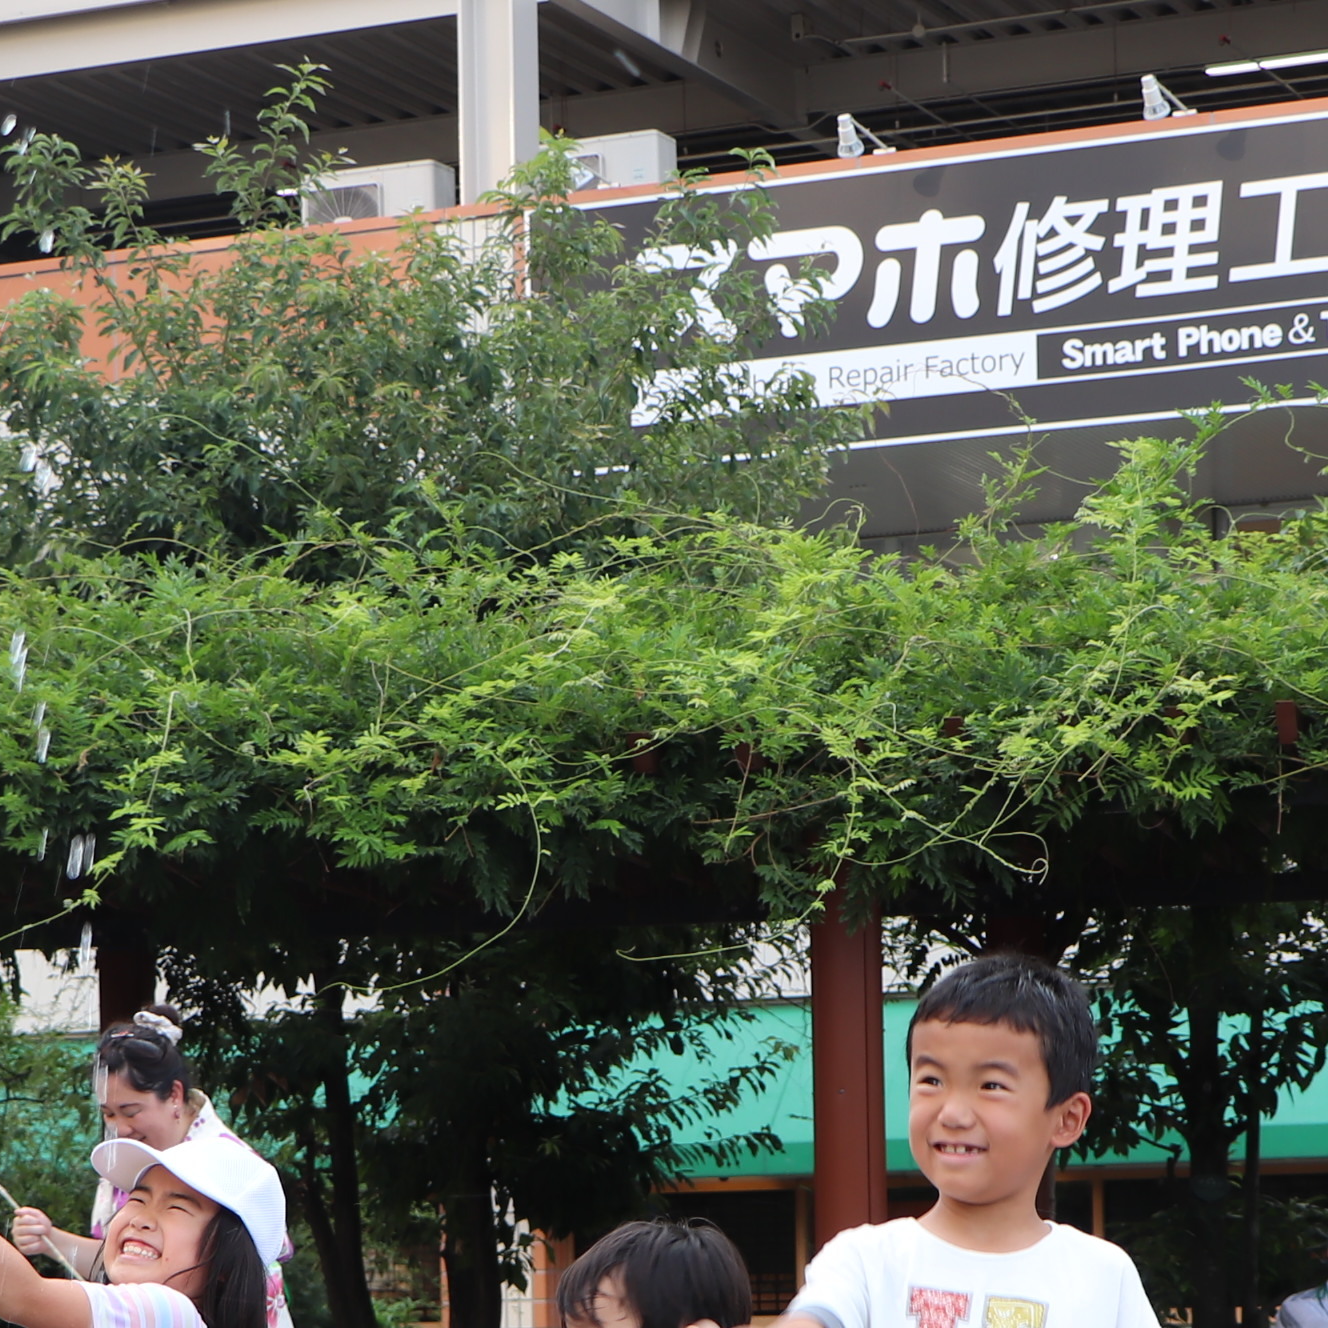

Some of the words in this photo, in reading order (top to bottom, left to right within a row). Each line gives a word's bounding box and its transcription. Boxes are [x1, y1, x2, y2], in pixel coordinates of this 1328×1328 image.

[1061, 334, 1166, 370] Smart
[1178, 323, 1283, 357] Phone
[1288, 313, 1316, 344] &
[828, 358, 914, 393] Repair
[924, 350, 1026, 379] Factory
